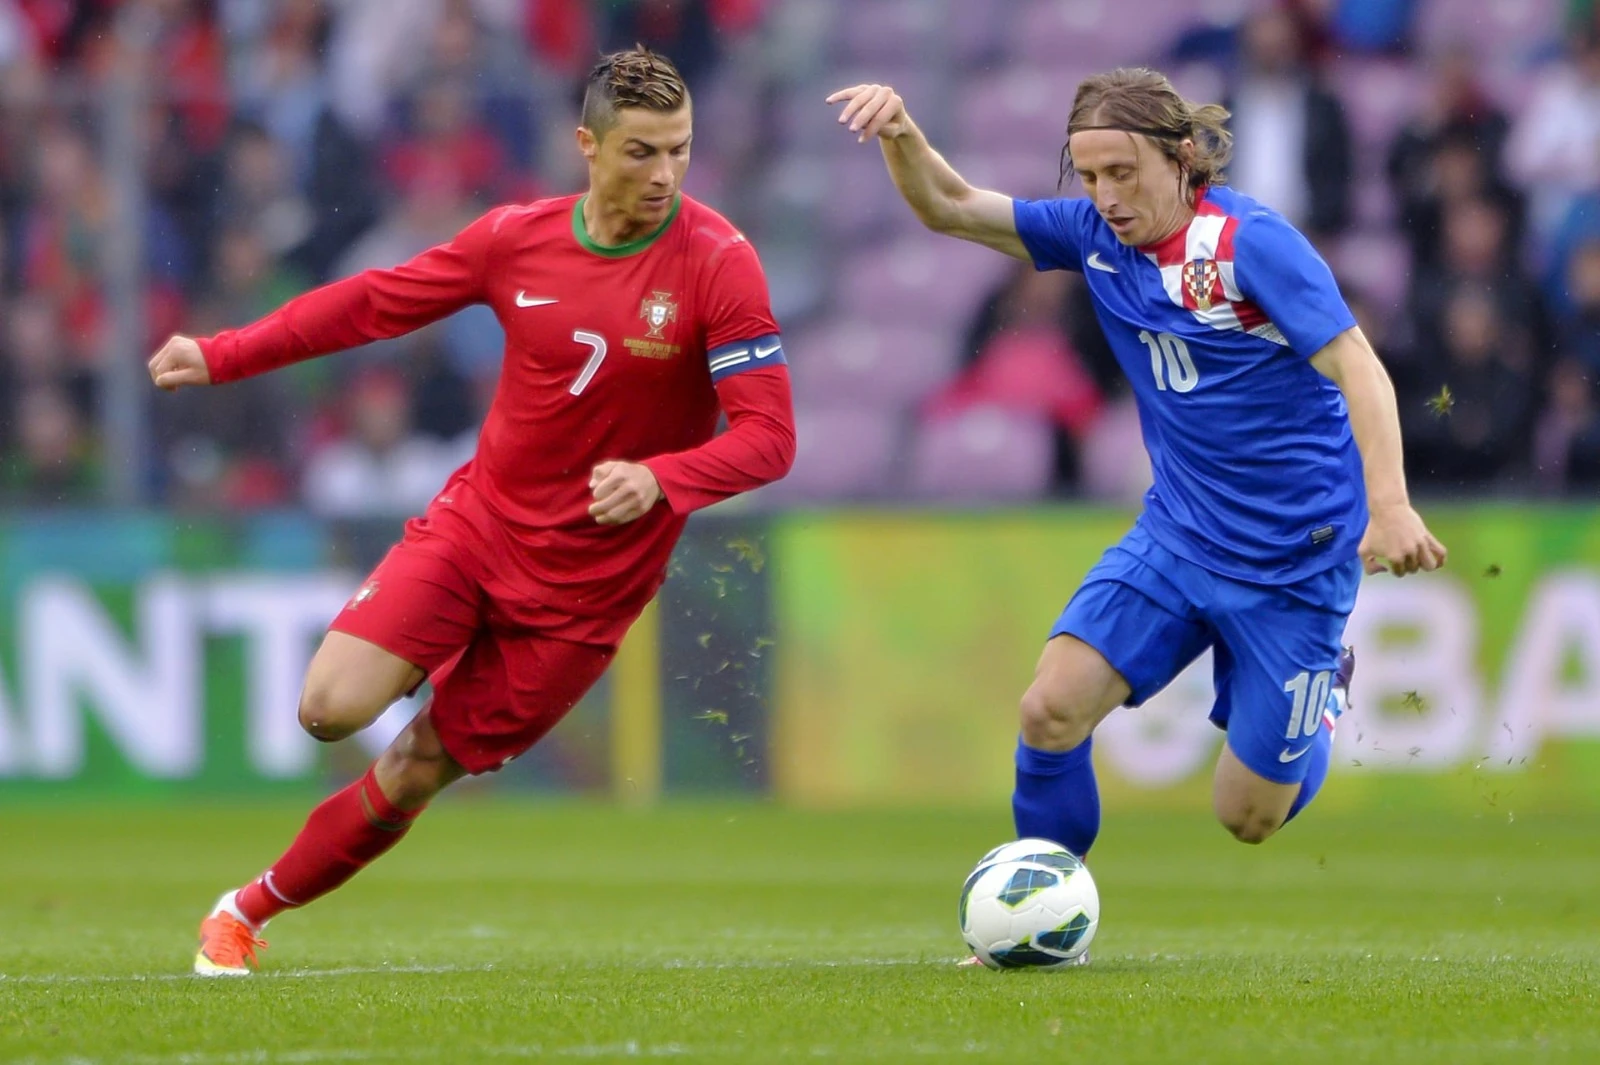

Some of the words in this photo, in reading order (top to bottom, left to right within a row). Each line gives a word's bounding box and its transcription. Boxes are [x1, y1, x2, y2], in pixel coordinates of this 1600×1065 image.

[569, 329, 607, 396] 7
[1139, 331, 1199, 393] 10
[0, 570, 432, 780] NT
[1284, 669, 1331, 739] 10
